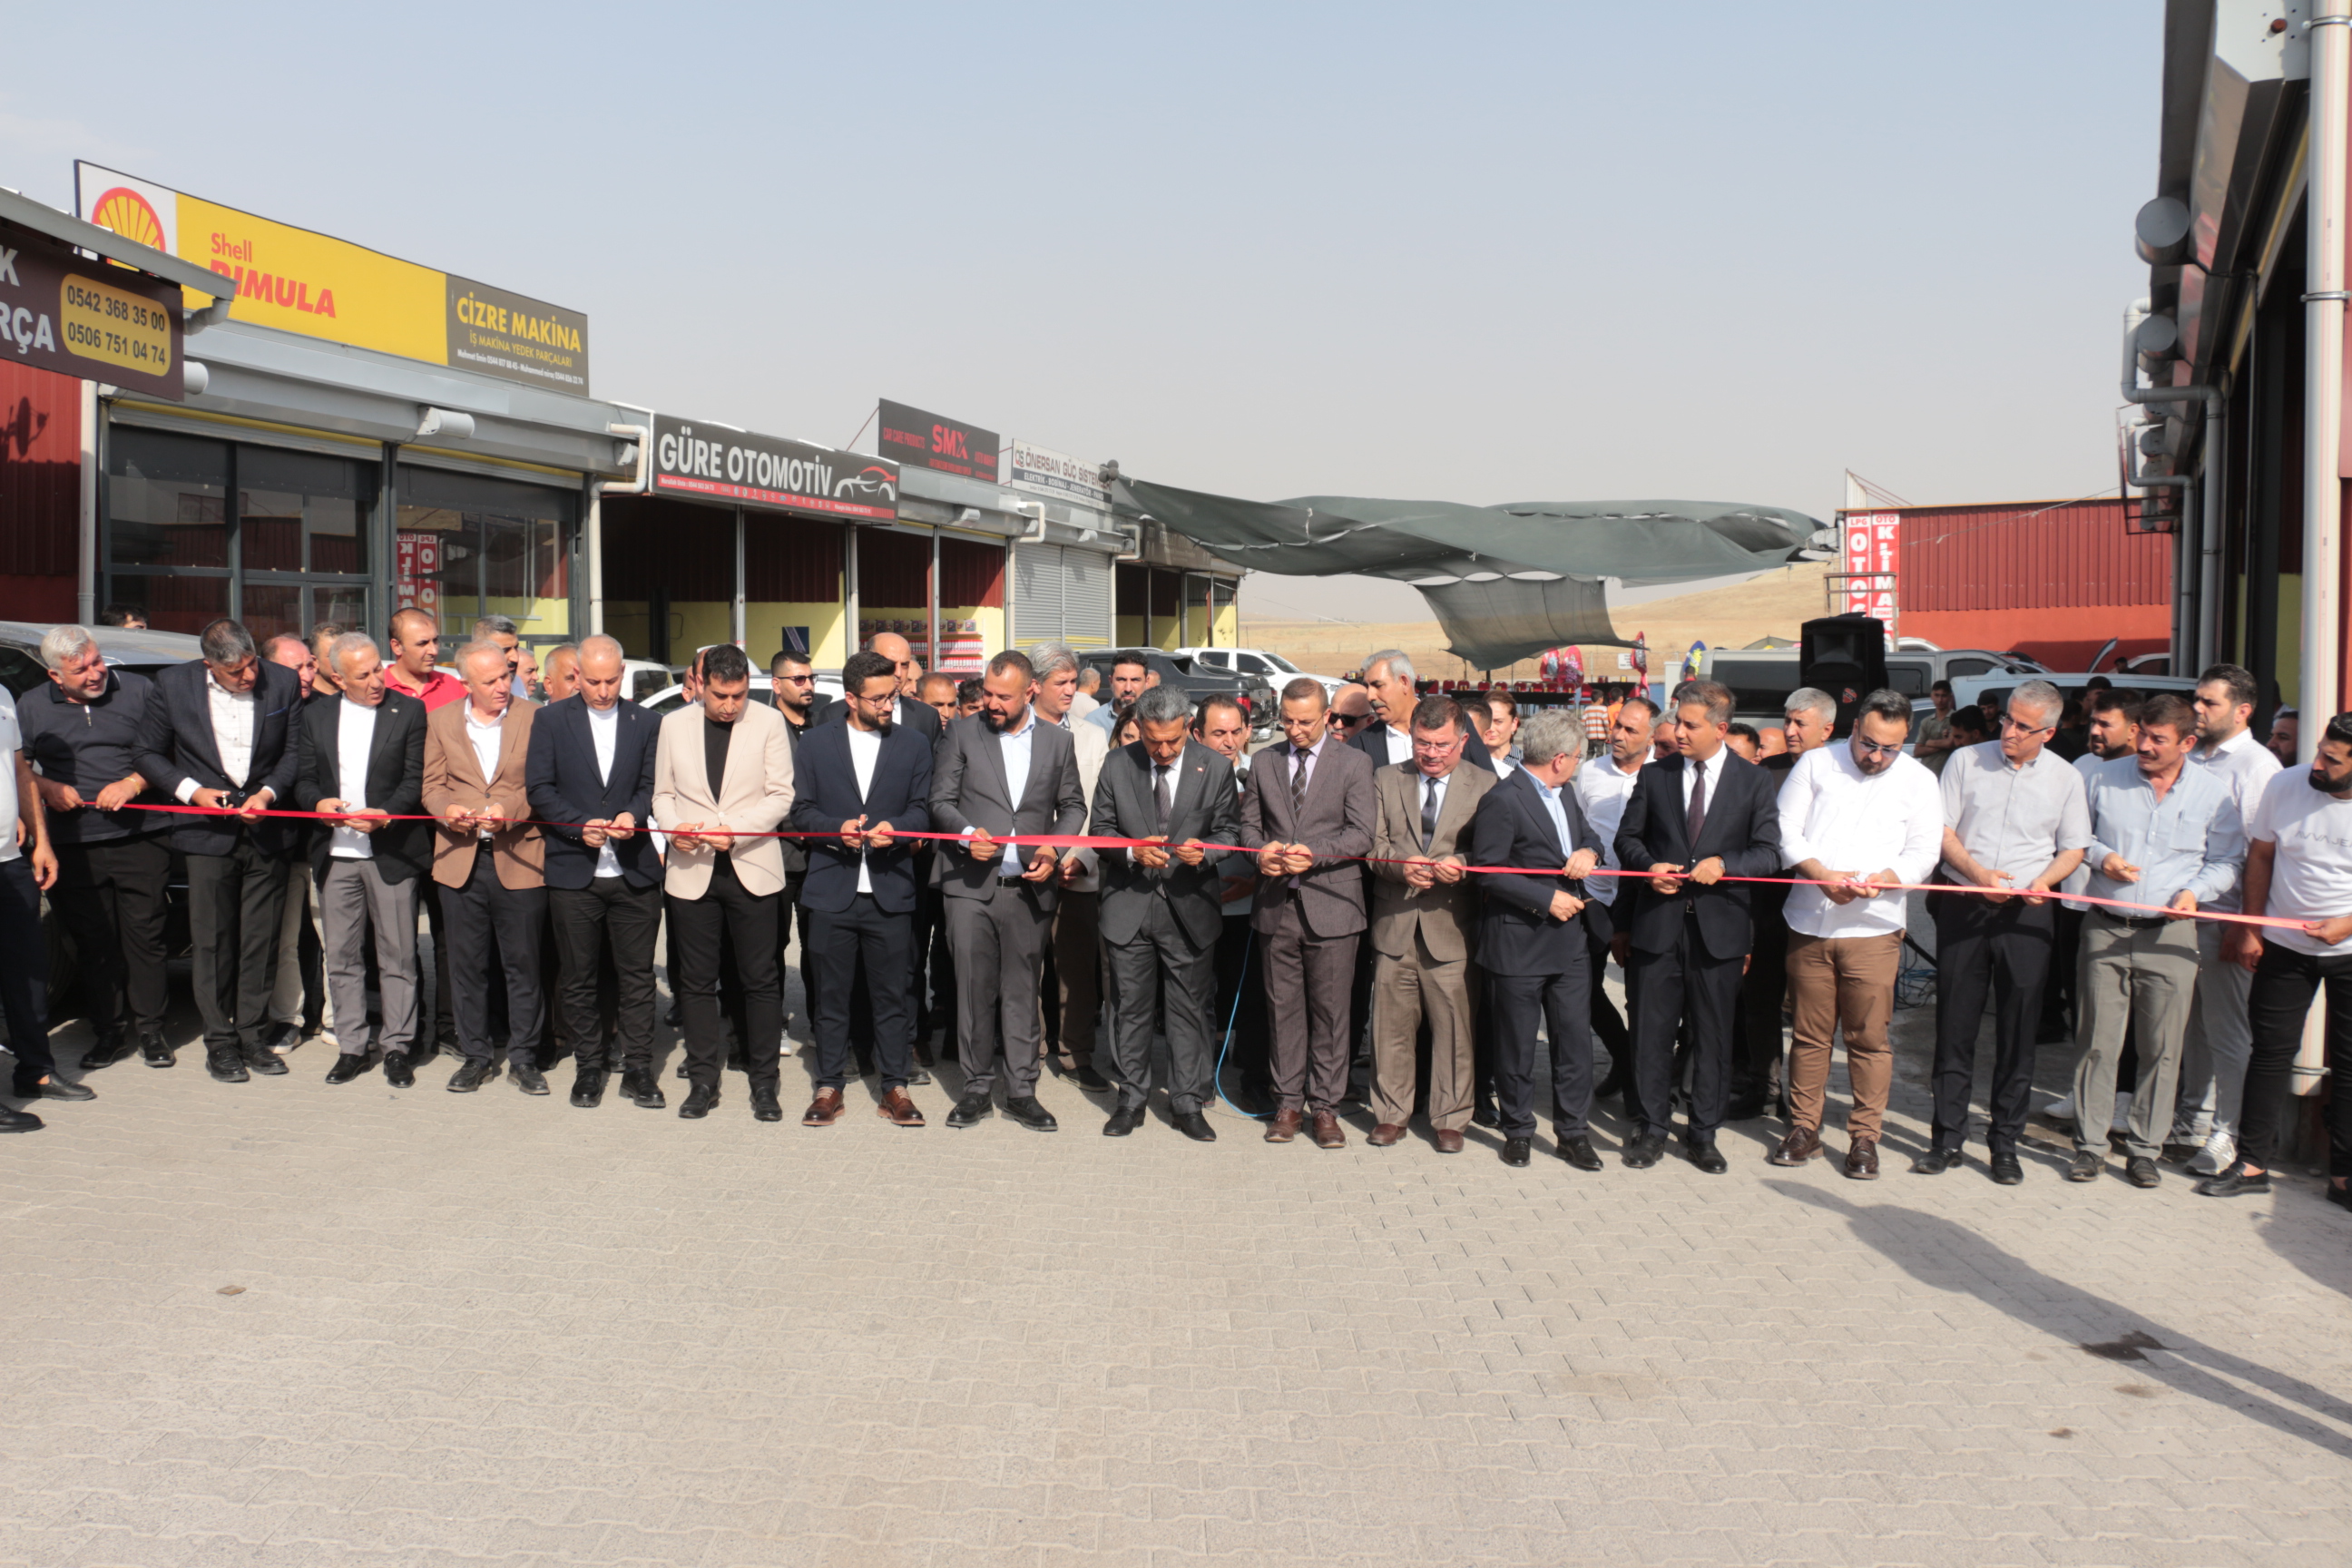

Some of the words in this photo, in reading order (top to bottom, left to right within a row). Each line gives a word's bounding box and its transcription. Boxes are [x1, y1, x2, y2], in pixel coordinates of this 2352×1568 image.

[211, 232, 252, 263] Shell
[67, 285, 101, 313] 0542
[105, 297, 129, 321] 368
[132, 306, 147, 327] 35
[151, 311, 165, 332] 00
[456, 291, 507, 333] CİZRE
[511, 311, 582, 353] MAKİNA
[68, 322, 101, 348] 0506
[105, 332, 128, 356] 751
[132, 340, 147, 361] 04
[151, 345, 165, 366] 74
[469, 329, 477, 347] İŞ
[478, 335, 511, 352] MAKİNA
[511, 343, 534, 358] YEDEK
[535, 349, 573, 368] PARÇALARI
[659, 426, 722, 478] GÜRE
[727, 446, 832, 496] OTOMOTİV
[932, 424, 971, 460] SMX
[1876, 515, 1896, 524] OTO
